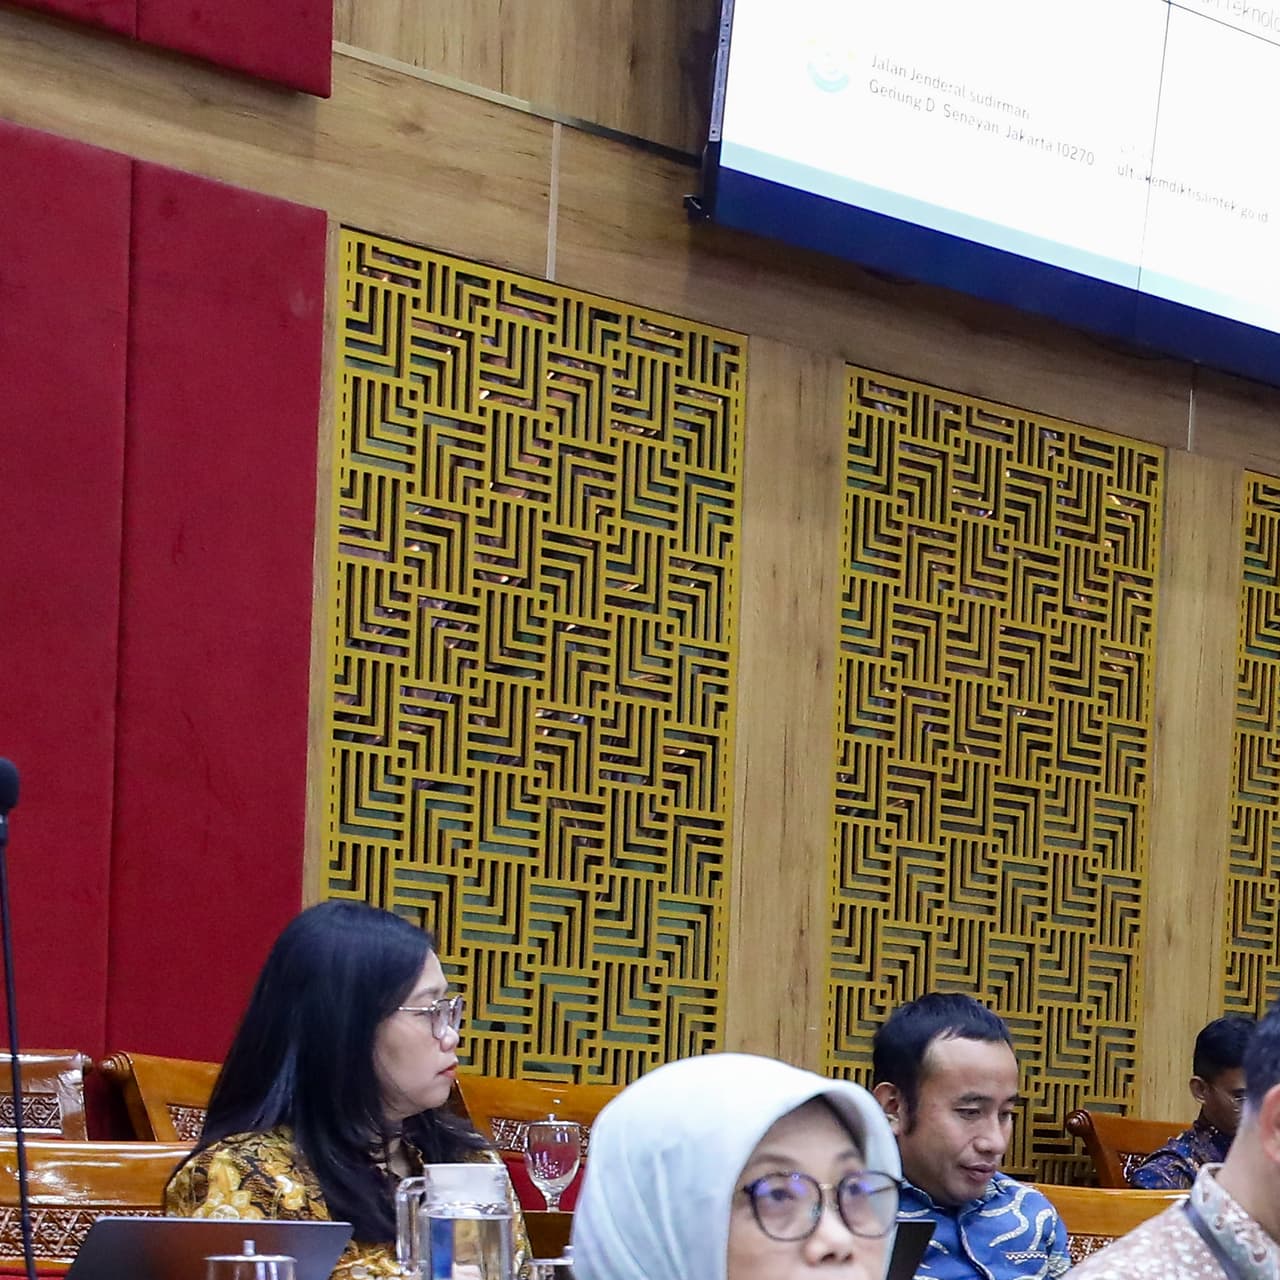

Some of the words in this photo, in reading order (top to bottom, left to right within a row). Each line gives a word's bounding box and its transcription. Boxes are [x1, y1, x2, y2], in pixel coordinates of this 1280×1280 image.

[871, 54, 906, 79] Jalan
[910, 67, 965, 98] Jenderal
[1056, 142, 1096, 166] 10270
